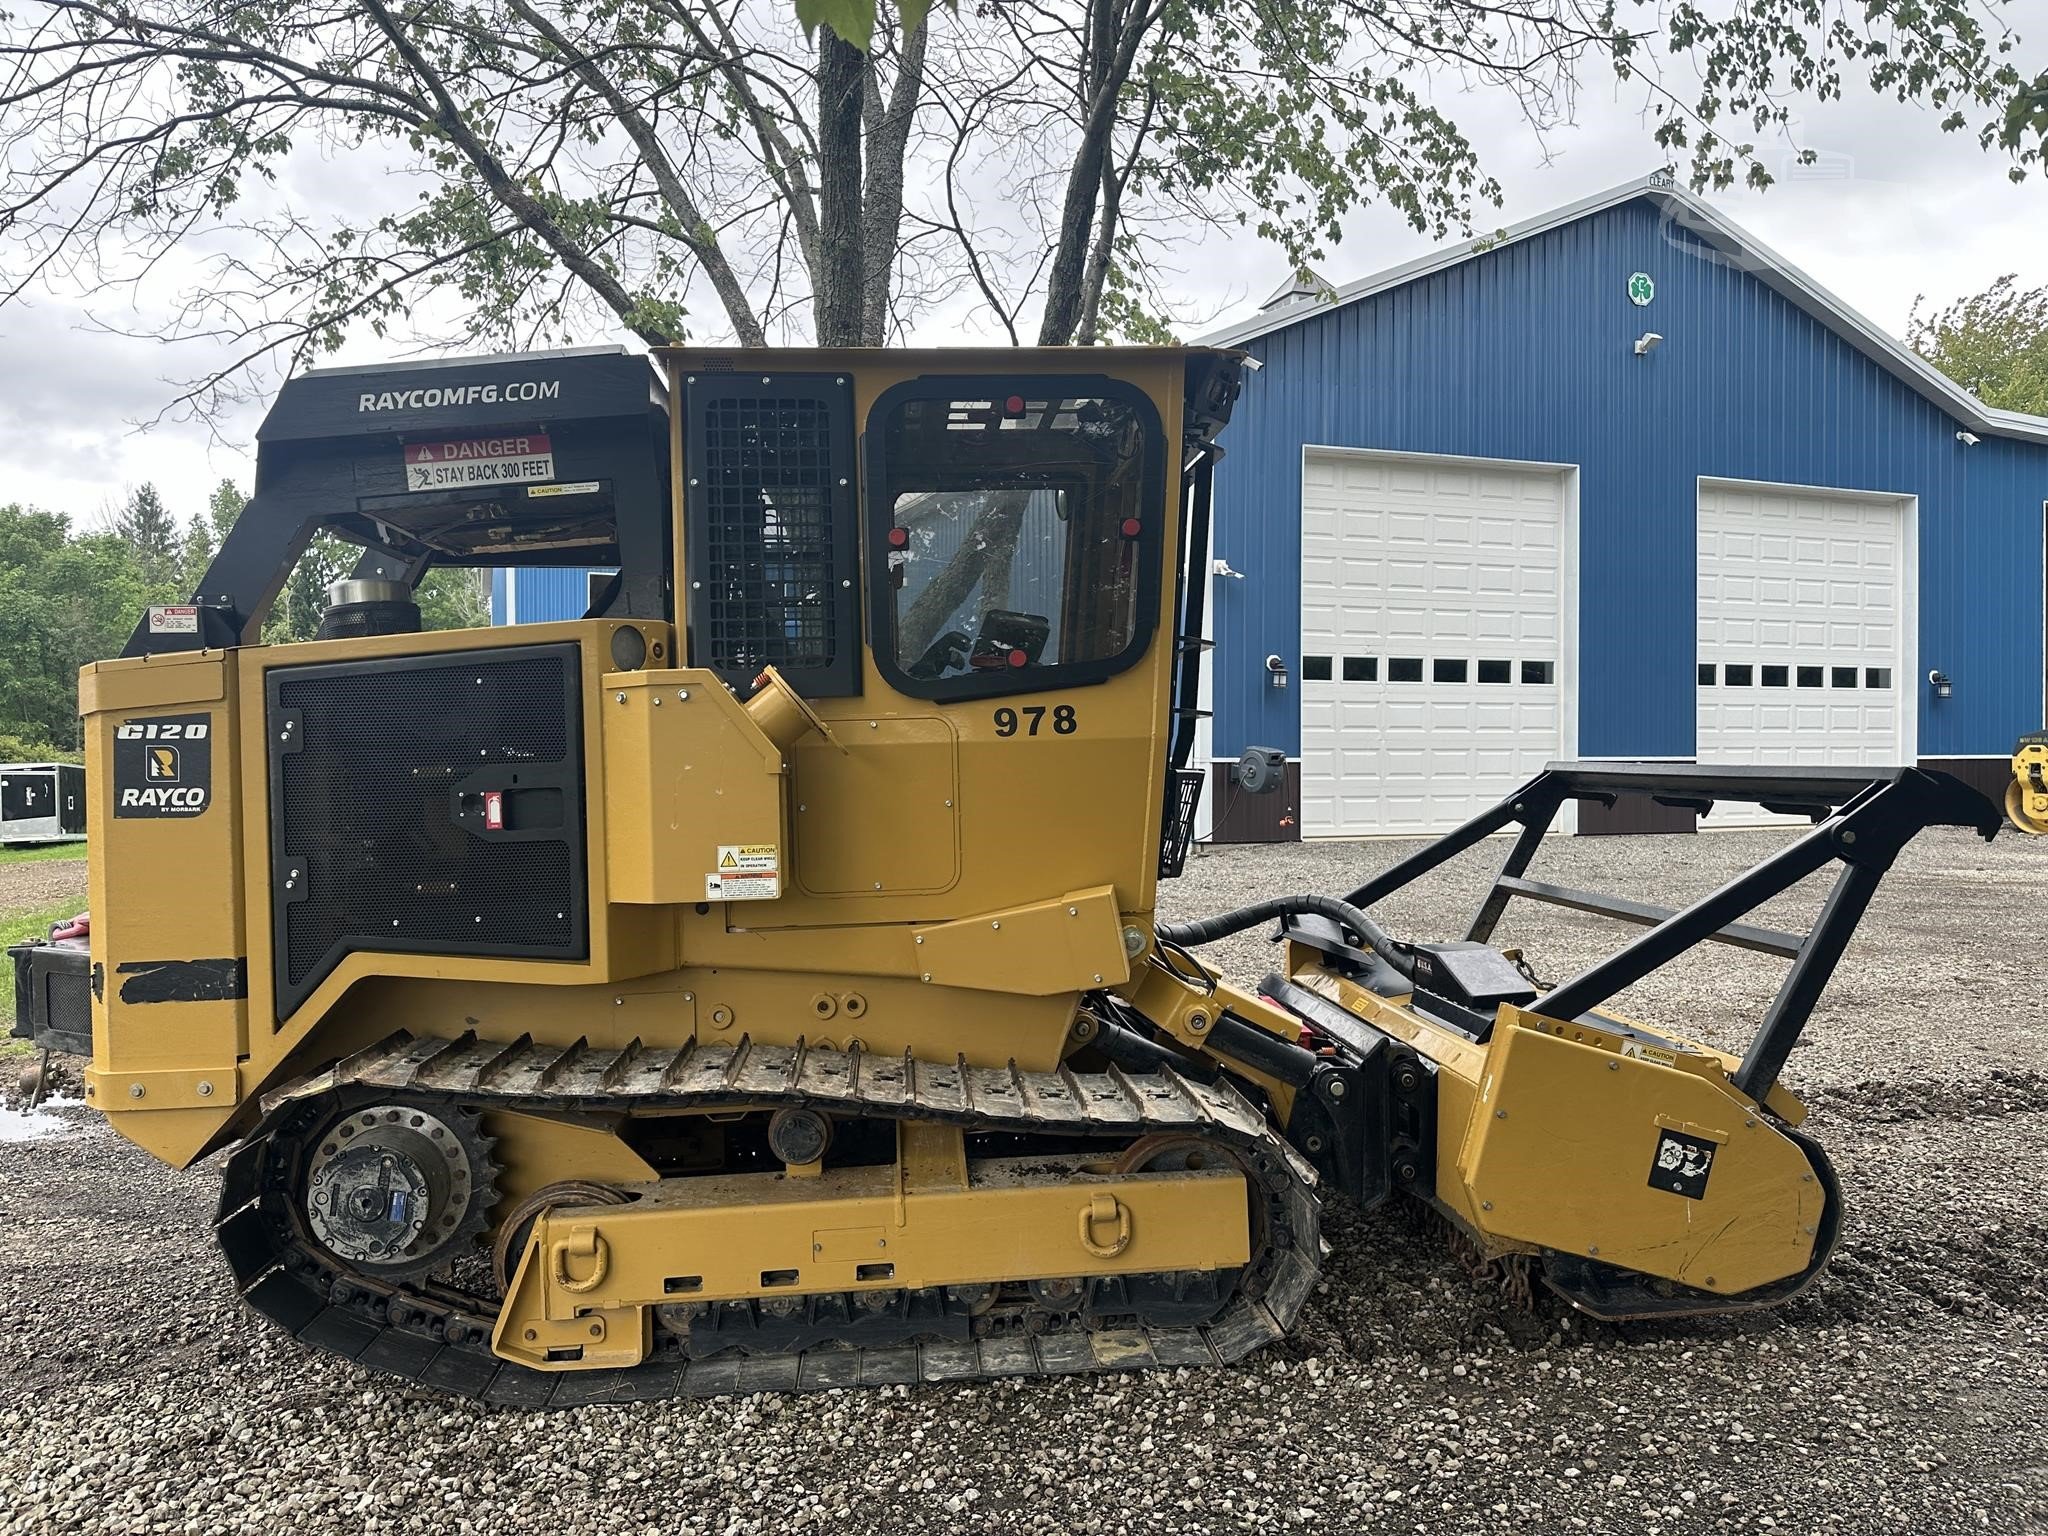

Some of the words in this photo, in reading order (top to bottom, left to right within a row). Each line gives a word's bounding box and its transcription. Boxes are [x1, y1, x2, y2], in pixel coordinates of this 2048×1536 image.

[1649, 177, 1675, 189] CLEARY
[359, 381, 560, 412] RAYCOMFG.COM
[443, 438, 530, 460] DANGER
[436, 466, 465, 484] STAY
[468, 464, 498, 481] BACK
[501, 462, 520, 478] 300
[523, 459, 550, 476] FEET
[993, 704, 1078, 738] 978
[121, 787, 205, 807] RAYCO
[1648, 1049, 1674, 1061] CAUTION
